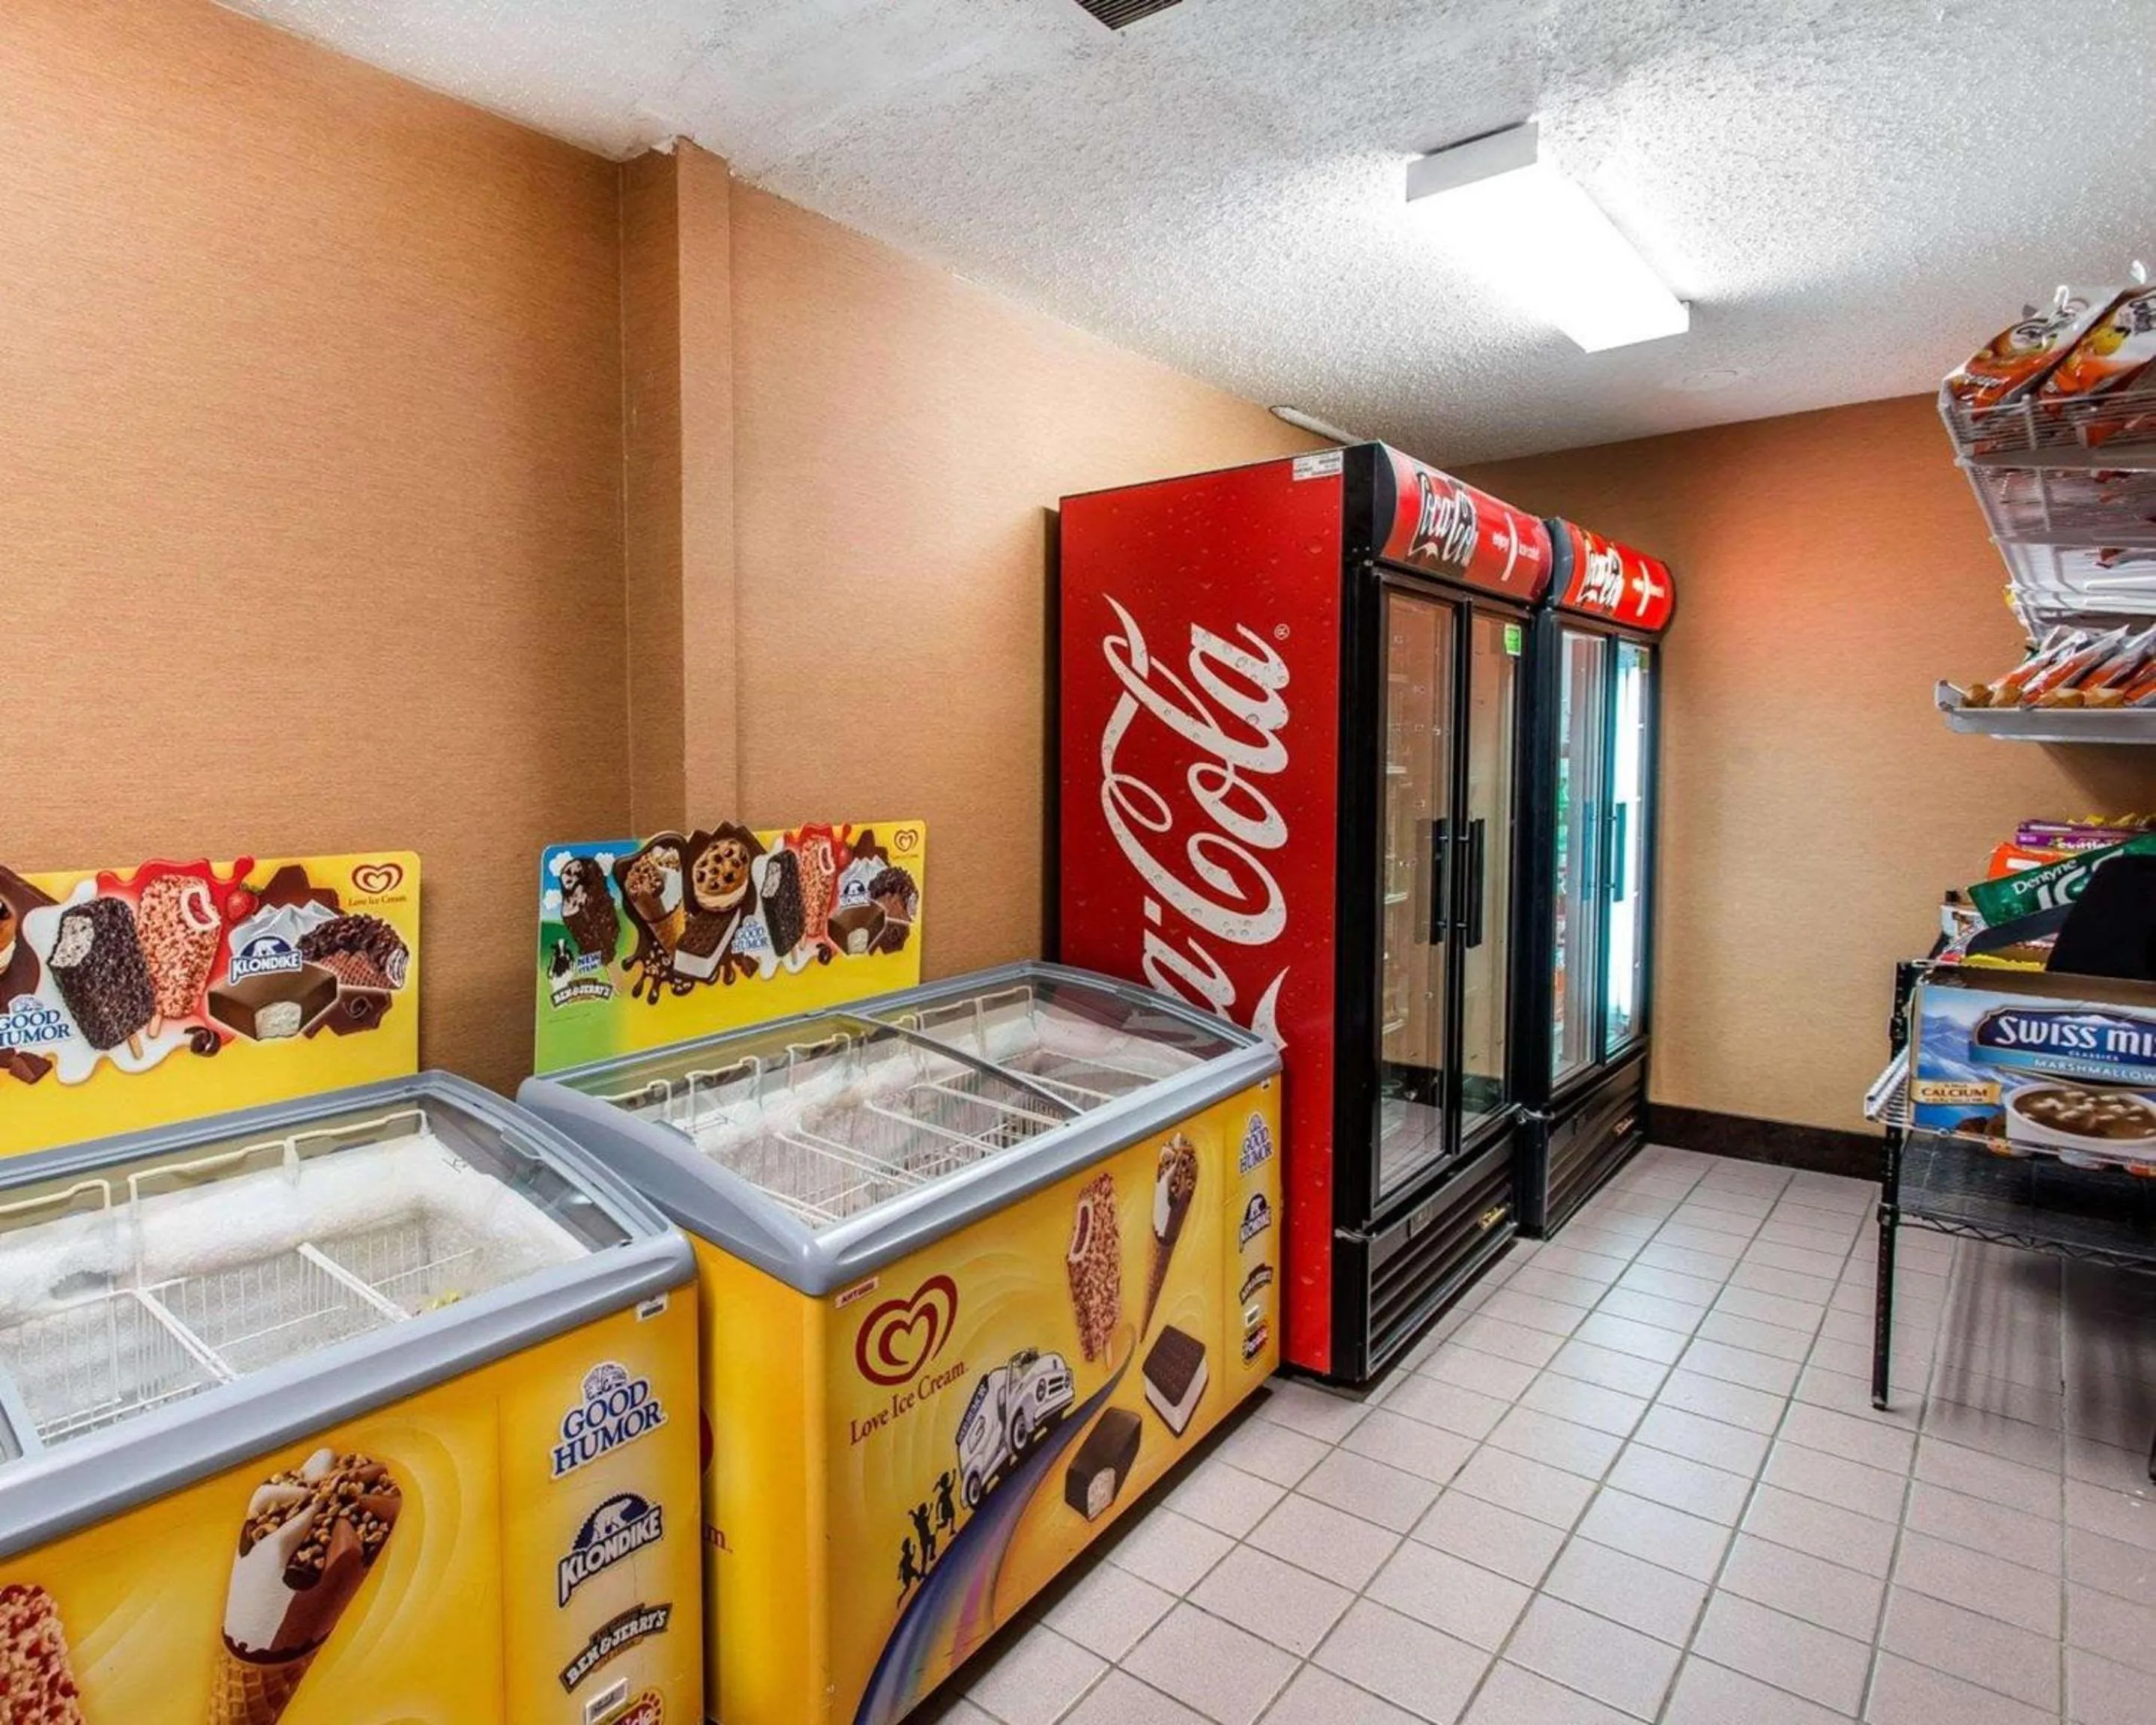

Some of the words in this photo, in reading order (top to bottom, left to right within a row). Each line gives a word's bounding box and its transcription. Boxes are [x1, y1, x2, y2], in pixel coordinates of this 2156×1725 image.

[2012, 859, 2078, 895] Dentyne
[231, 953, 300, 982] KLONDIKE
[2067, 1050, 2119, 1062] CLASSICS
[1921, 1088, 1988, 1098] CALCIUM
[563, 1380, 648, 1439] GOOD
[850, 1409, 889, 1446] Love
[892, 1393, 915, 1420] Ice
[918, 1361, 965, 1401] Cream
[553, 1401, 662, 1476] HUMOR
[560, 1507, 661, 1607] KLONDIKE
